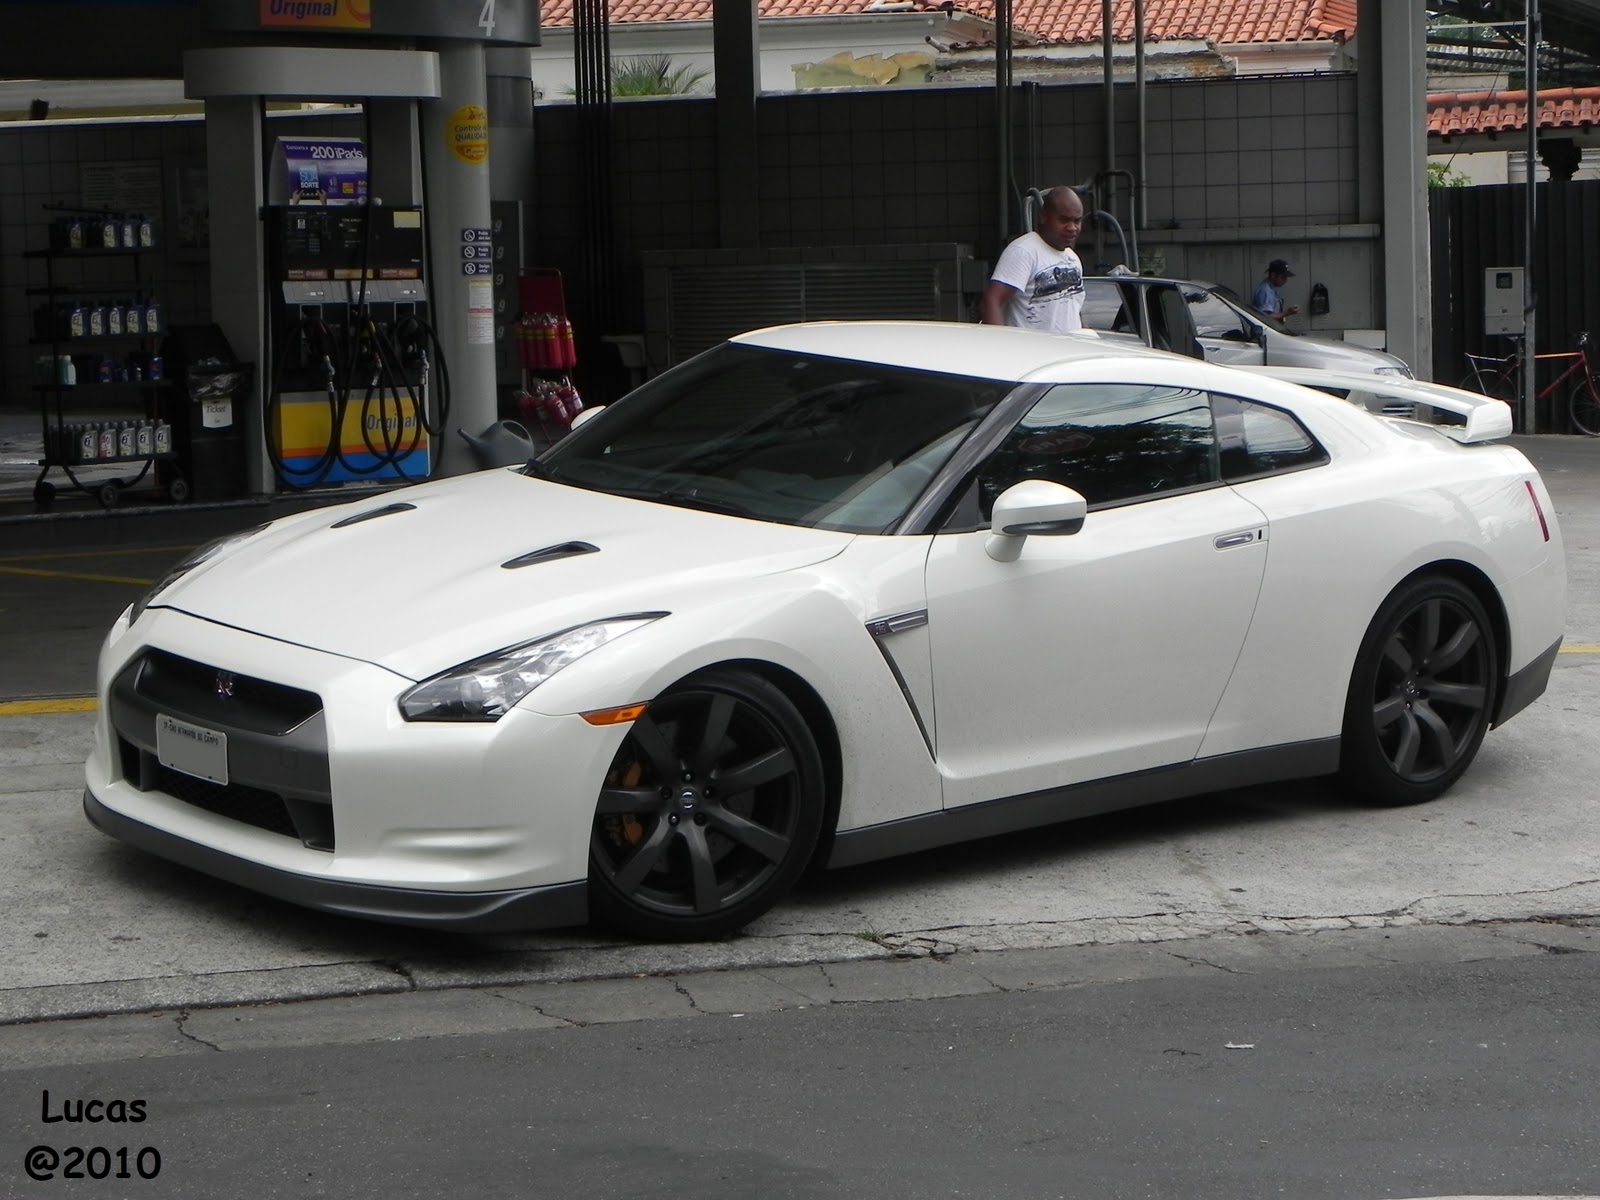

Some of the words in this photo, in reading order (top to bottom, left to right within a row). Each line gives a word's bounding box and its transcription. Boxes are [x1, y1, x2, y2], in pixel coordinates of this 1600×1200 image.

[478, 0, 495, 37] 4
[310, 146, 335, 159] 200
[335, 147, 364, 159] iPads
[300, 181, 320, 189] SORTE
[366, 413, 417, 432] Orgial
